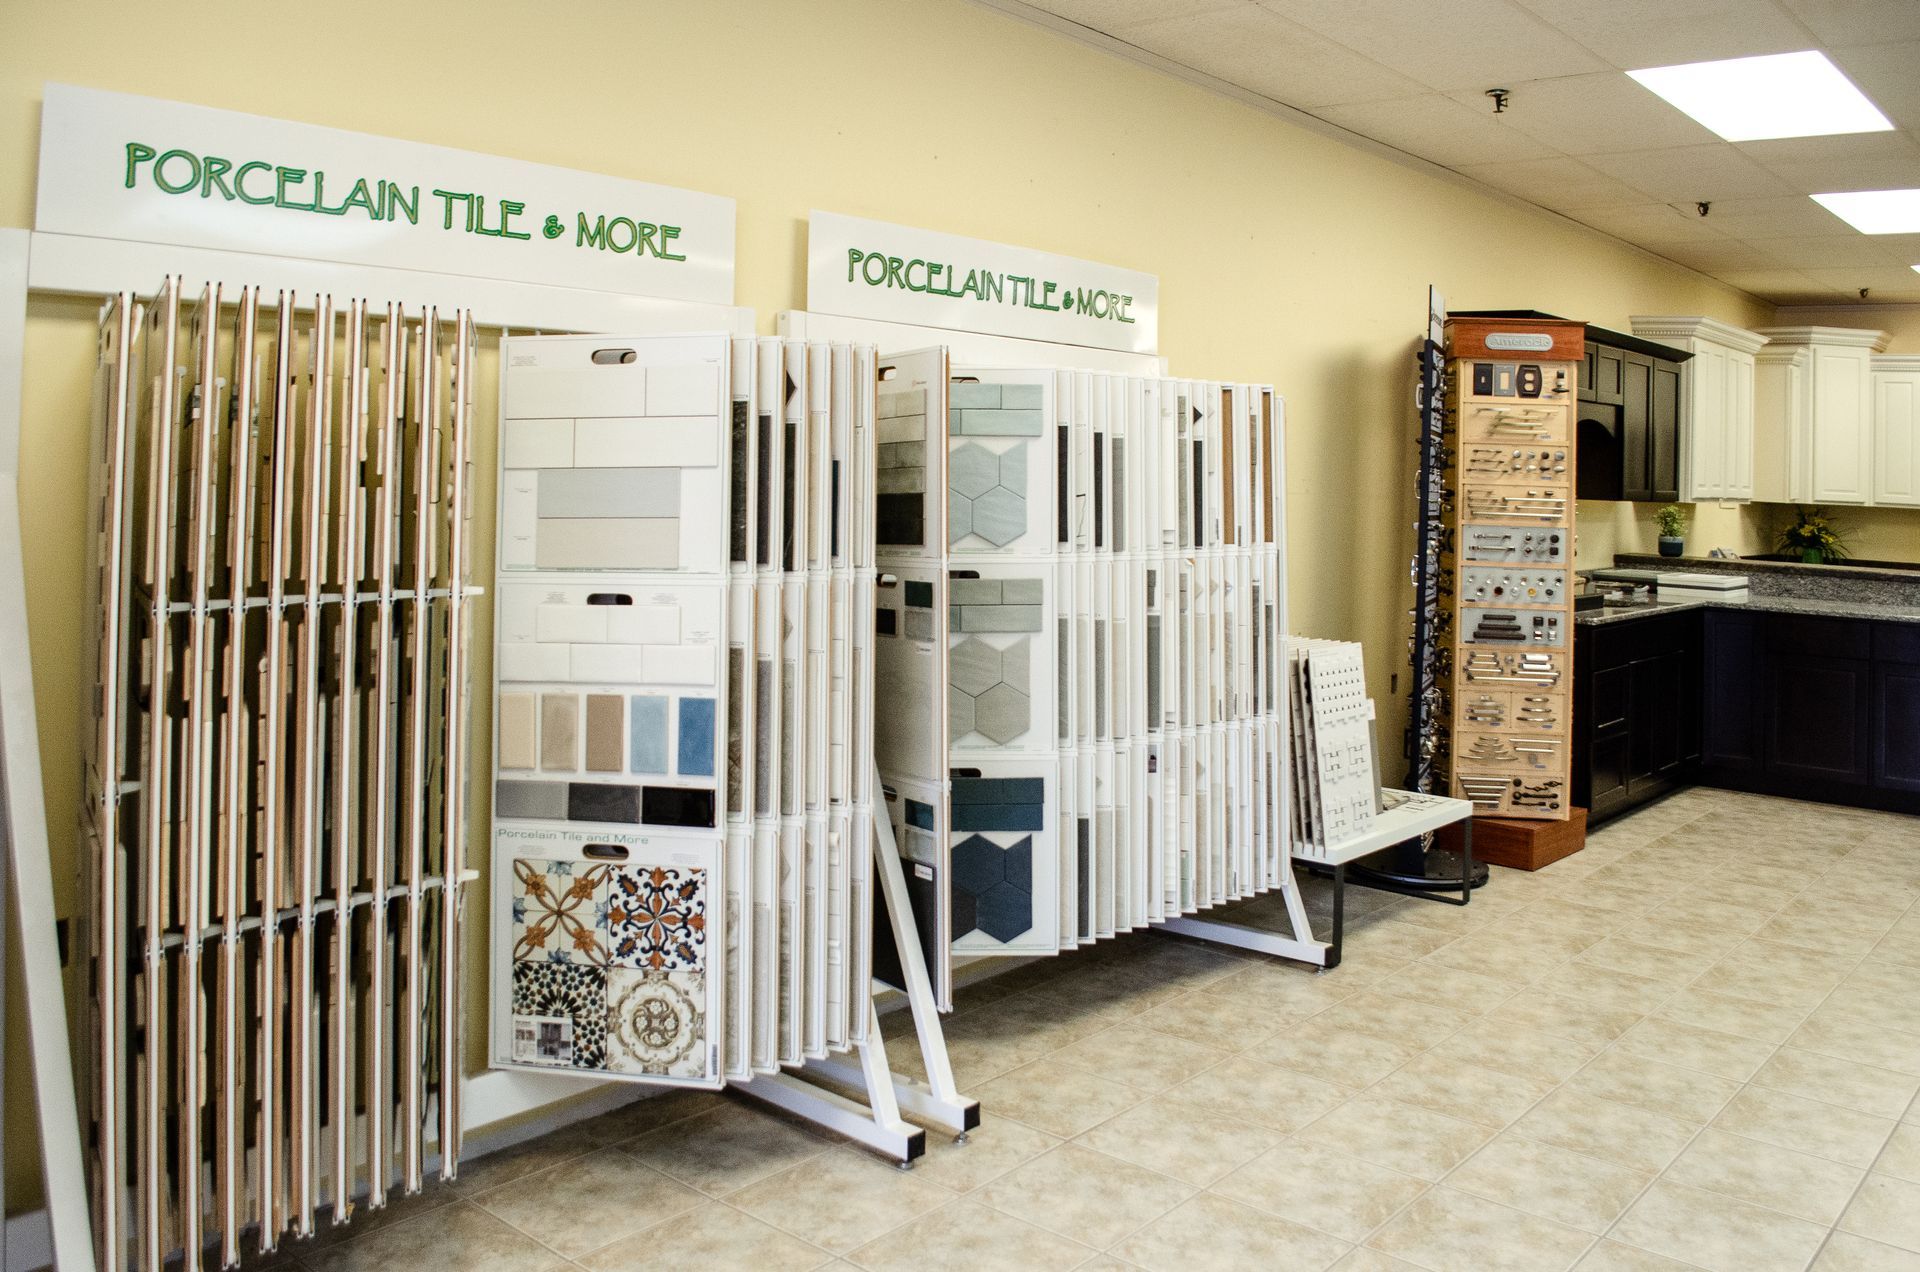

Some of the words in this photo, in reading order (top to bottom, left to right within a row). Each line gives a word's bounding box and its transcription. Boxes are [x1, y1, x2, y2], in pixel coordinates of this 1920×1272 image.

[124, 142, 419, 225] PORCELAIN
[432, 189, 531, 240] TILE
[542, 214, 565, 240] &
[576, 210, 688, 262] MORE
[847, 247, 1004, 304] PORCELAIN
[1007, 273, 1060, 311] TILE
[1062, 290, 1075, 311] &
[1076, 286, 1136, 324] MORE
[498, 828, 557, 840] Porcelain
[561, 831, 583, 841] Tile
[586, 833, 609, 843] and
[614, 834, 649, 845] More
